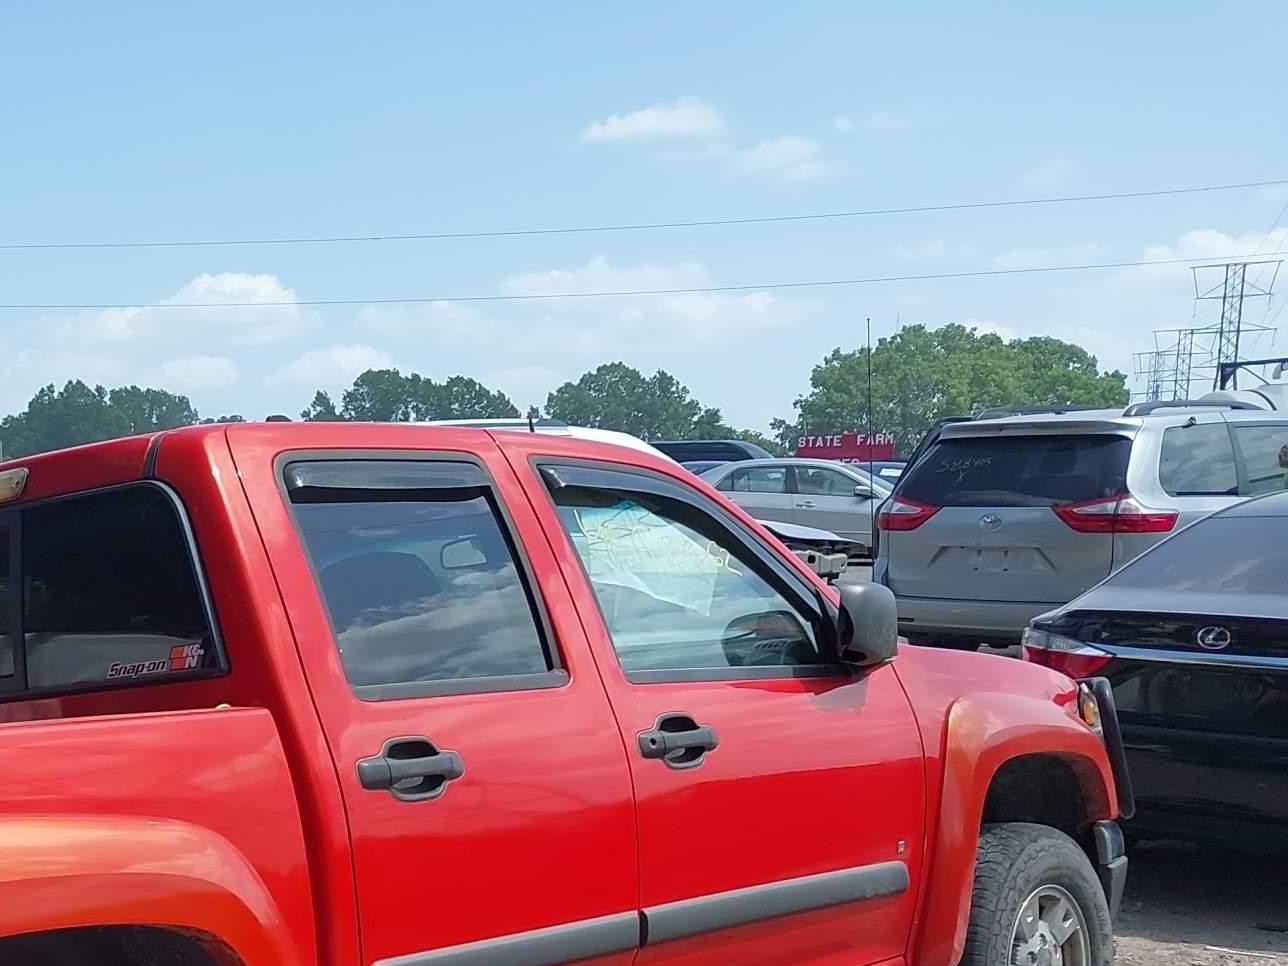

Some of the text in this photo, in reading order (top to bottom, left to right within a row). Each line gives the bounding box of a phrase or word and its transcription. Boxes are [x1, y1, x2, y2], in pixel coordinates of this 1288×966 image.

[798, 432, 895, 448] STATE FARM
[107, 660, 167, 678] Snap-on
